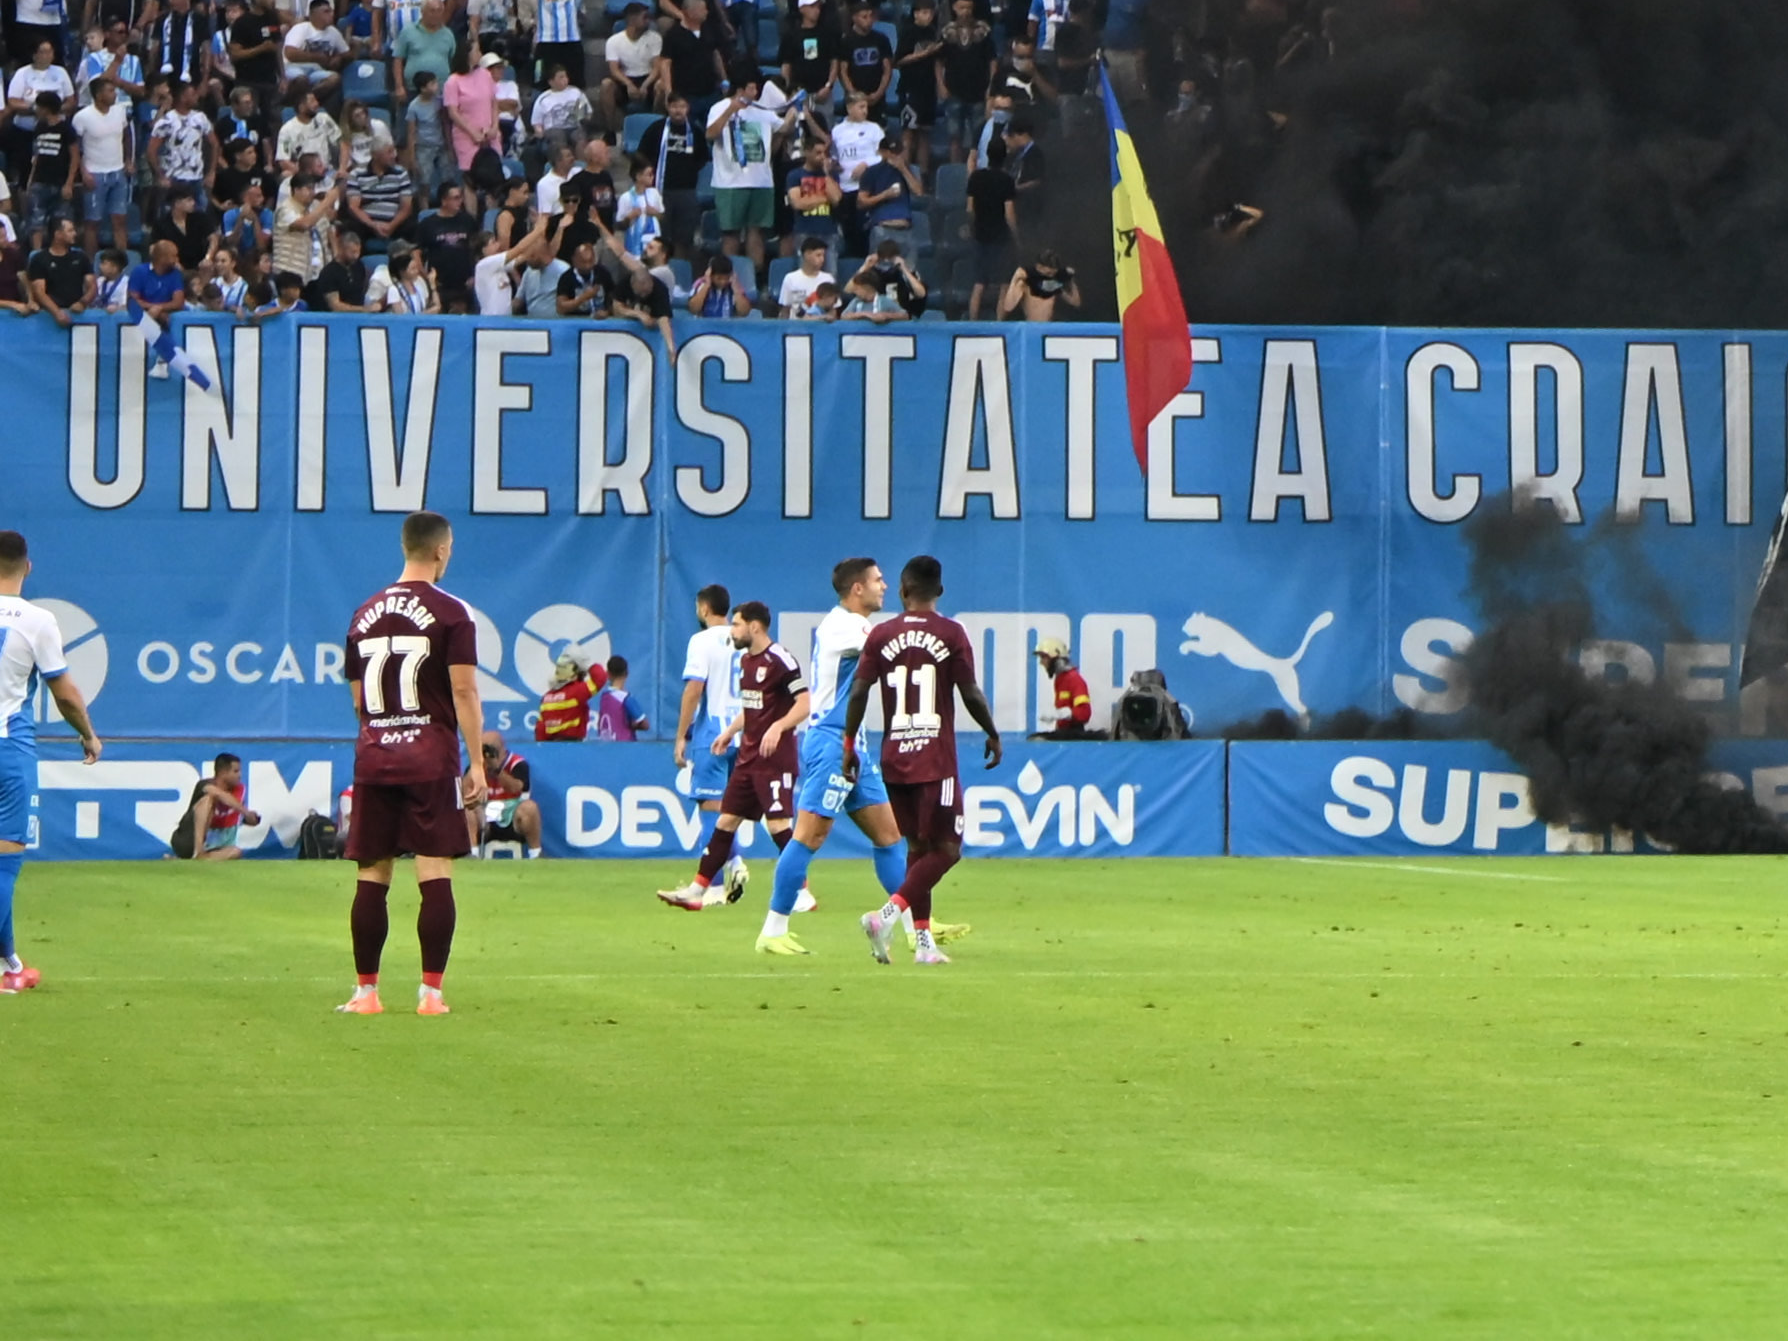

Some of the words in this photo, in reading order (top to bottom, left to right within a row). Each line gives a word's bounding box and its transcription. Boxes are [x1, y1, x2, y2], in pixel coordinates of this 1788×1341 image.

[67, 322, 1332, 523] UNIVERSITATEA
[136, 640, 346, 685] OSCAR
[357, 635, 431, 714] 77
[886, 664, 942, 730] 11
[963, 783, 1135, 851] EVIN
